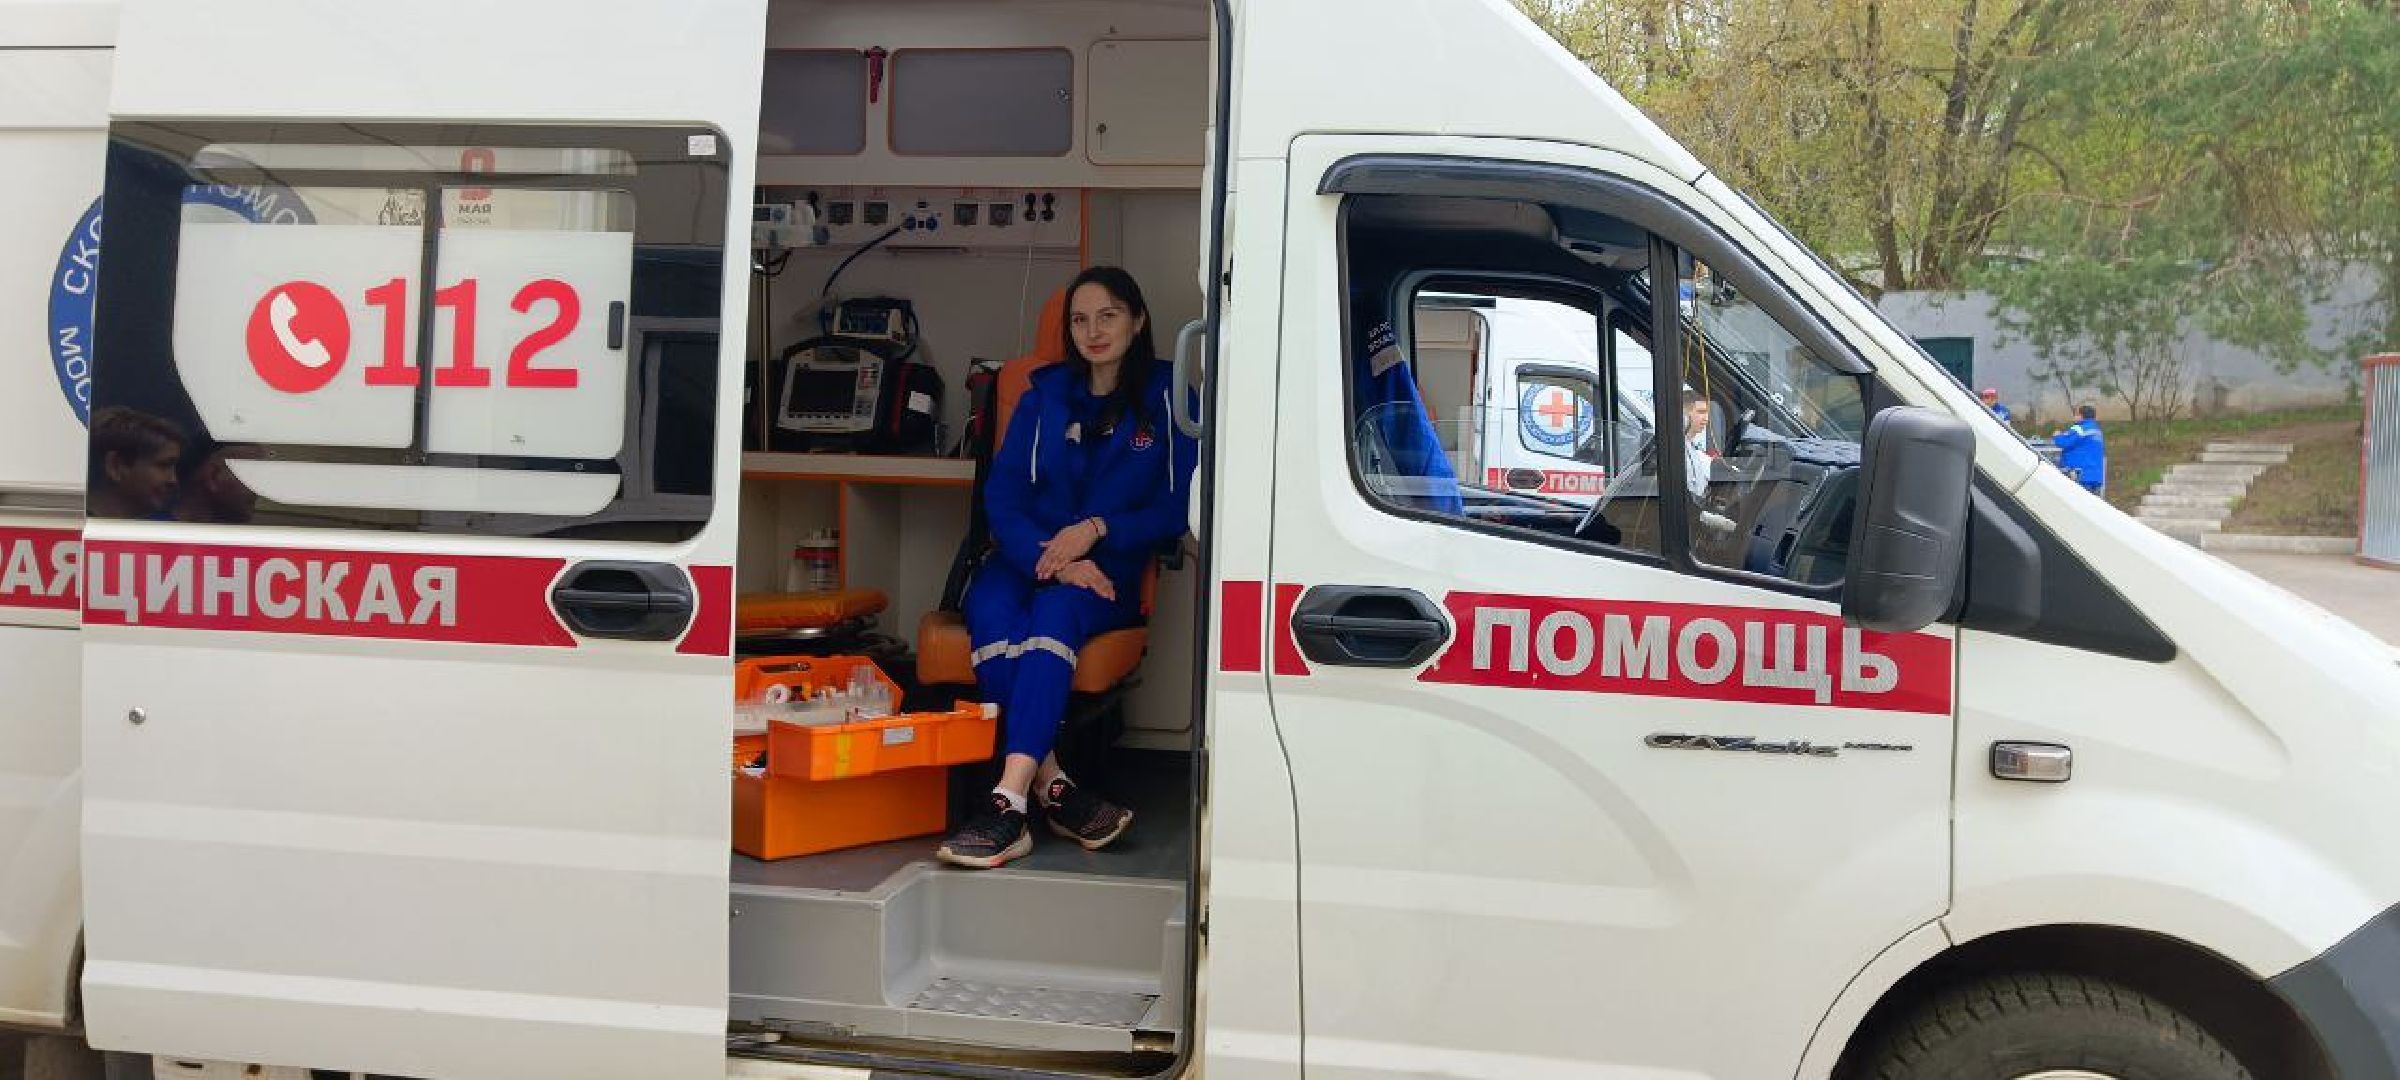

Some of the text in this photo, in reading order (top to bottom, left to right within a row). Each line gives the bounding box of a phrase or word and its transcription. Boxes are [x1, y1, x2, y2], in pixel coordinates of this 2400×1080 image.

[59, 326, 92, 411] МОС
[364, 278, 580, 388] 112
[1549, 472, 1604, 494] ПОМ
[0, 539, 81, 598] АЯ
[88, 552, 458, 627] ЦИНСКАЯ
[1472, 606, 1900, 704] ПОМОЩЬ
